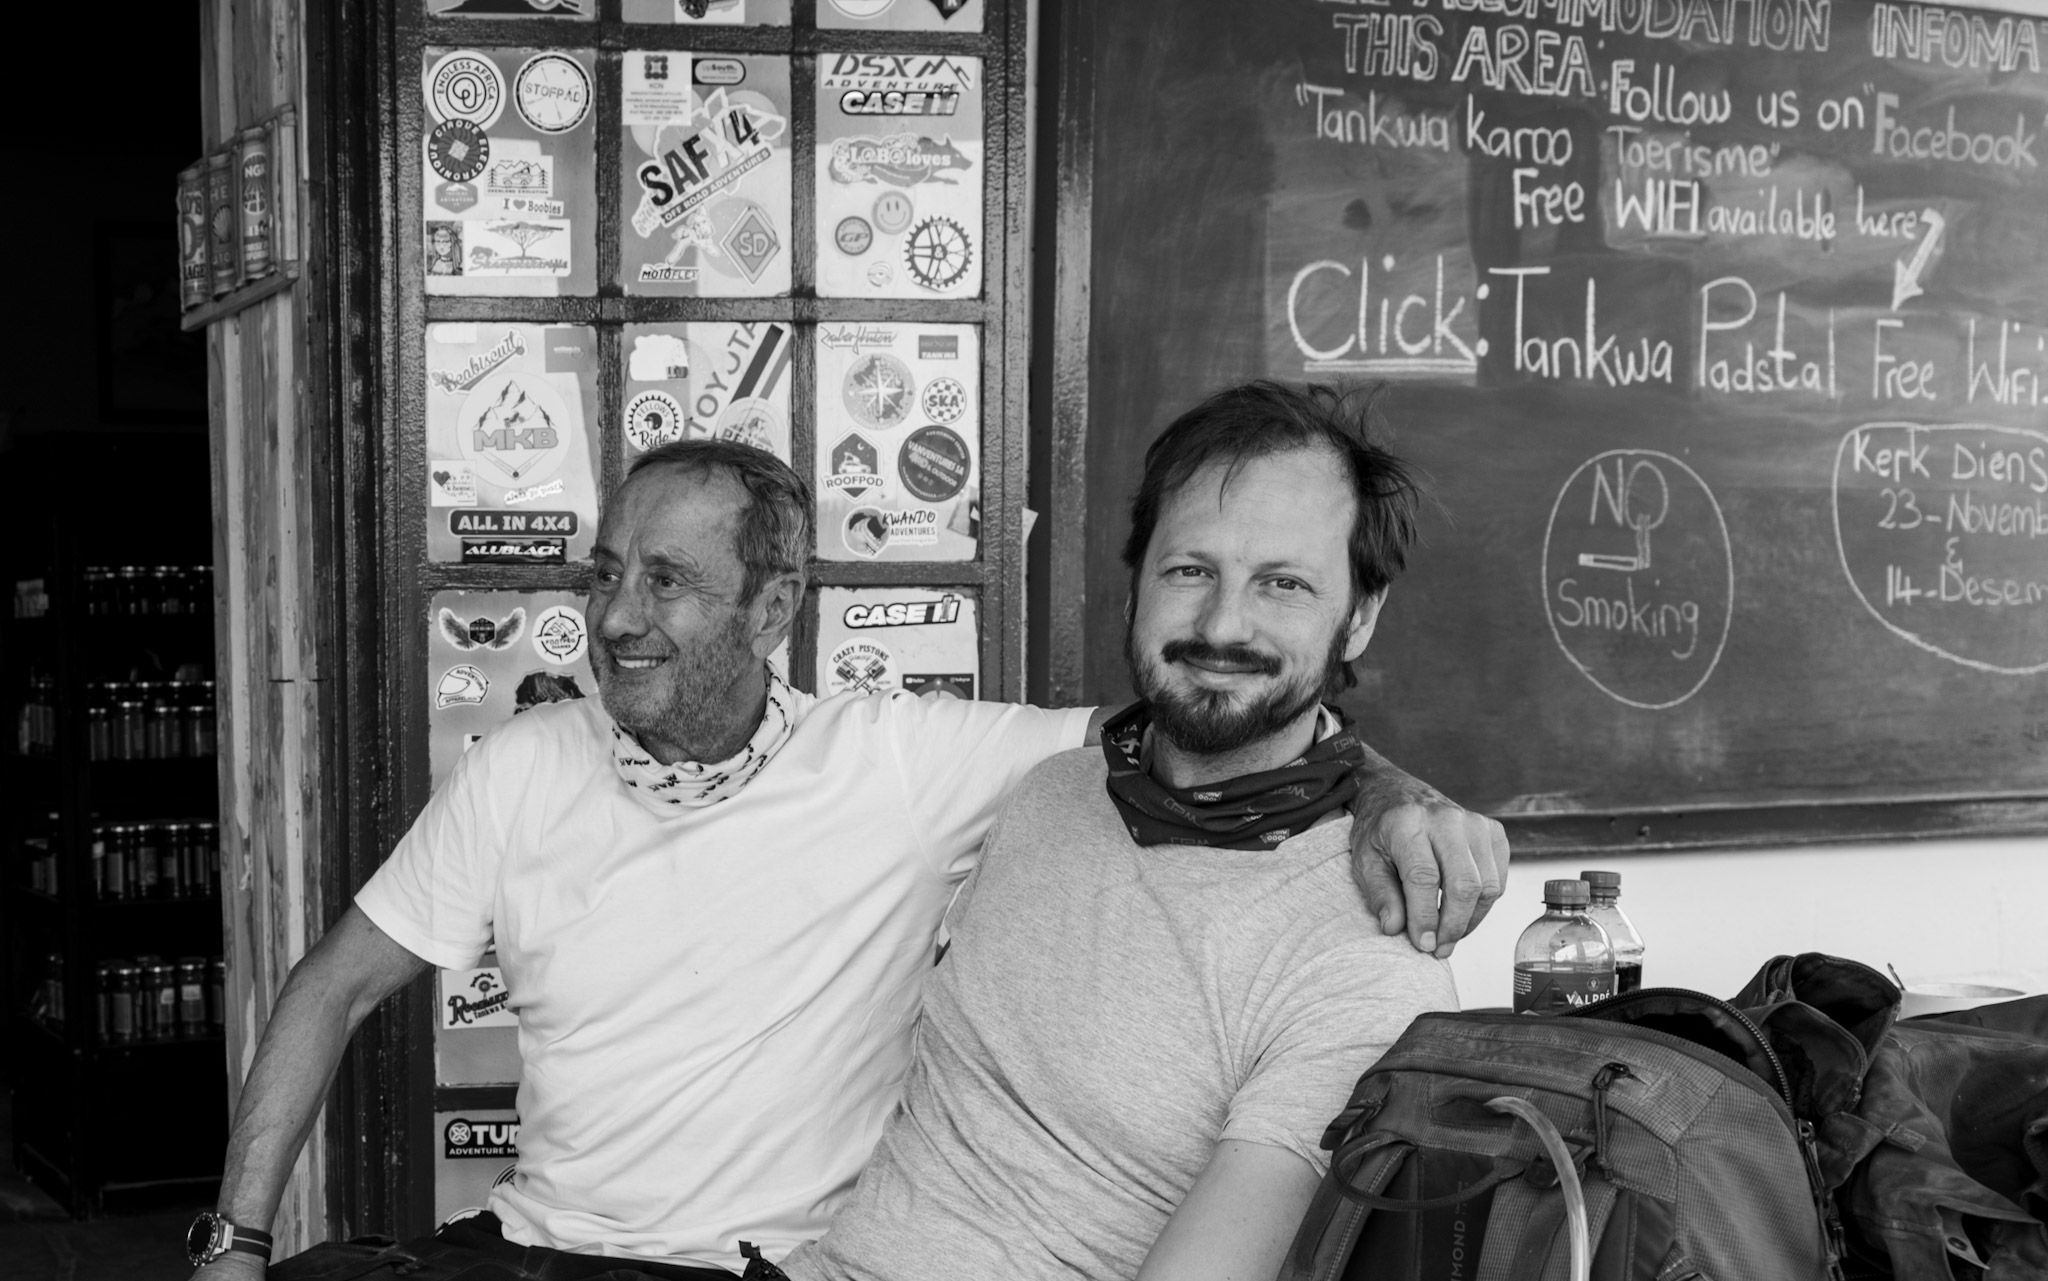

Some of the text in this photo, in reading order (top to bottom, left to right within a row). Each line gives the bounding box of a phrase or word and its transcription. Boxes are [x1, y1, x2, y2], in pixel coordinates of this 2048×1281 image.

[437, 61, 496, 100] ENDLESS AFRICA
[1333, 13, 1443, 80] THIS
[1610, 59, 1731, 125] Follow
[1757, 90, 1801, 128] us
[1817, 96, 1864, 131] on
[525, 82, 581, 103] STOFPAD
[824, 79, 958, 90] ADVENTURE
[841, 91, 926, 114] CASE
[665, 149, 769, 221] OFF ROAD ADVENTURES
[503, 198, 561, 215] I Boobies
[1513, 167, 1585, 228] Free
[1708, 184, 1836, 241] available
[1856, 184, 1917, 240] here
[739, 230, 769, 257] SD
[1488, 266, 1672, 387] Tankwa
[1700, 276, 1836, 399] Padstal
[1873, 319, 1936, 399] Free
[636, 402, 671, 419] FELLOWS
[928, 394, 960, 408] SKA
[473, 427, 558, 452] MKB
[639, 429, 669, 448] Ride
[1852, 429, 1930, 483] Kerk
[826, 475, 884, 488] ROOFPOD
[1591, 457, 1669, 530] NO
[457, 515, 571, 531] ALL IN 4X4
[882, 509, 936, 525] KWANDO
[890, 527, 936, 537] ADVENTURES
[465, 545, 562, 556] ALUBLACK
[845, 603, 928, 628] CASE
[1557, 577, 1699, 660] Smoking
[545, 637, 576, 646] FOOTPEG
[833, 644, 890, 664] CRAZY PISTONS
[456, 669, 485, 692] ADVENTURE
[449, 1147, 504, 1155] ADVENTURE
[1450, 1220, 1466, 1281] MOND
